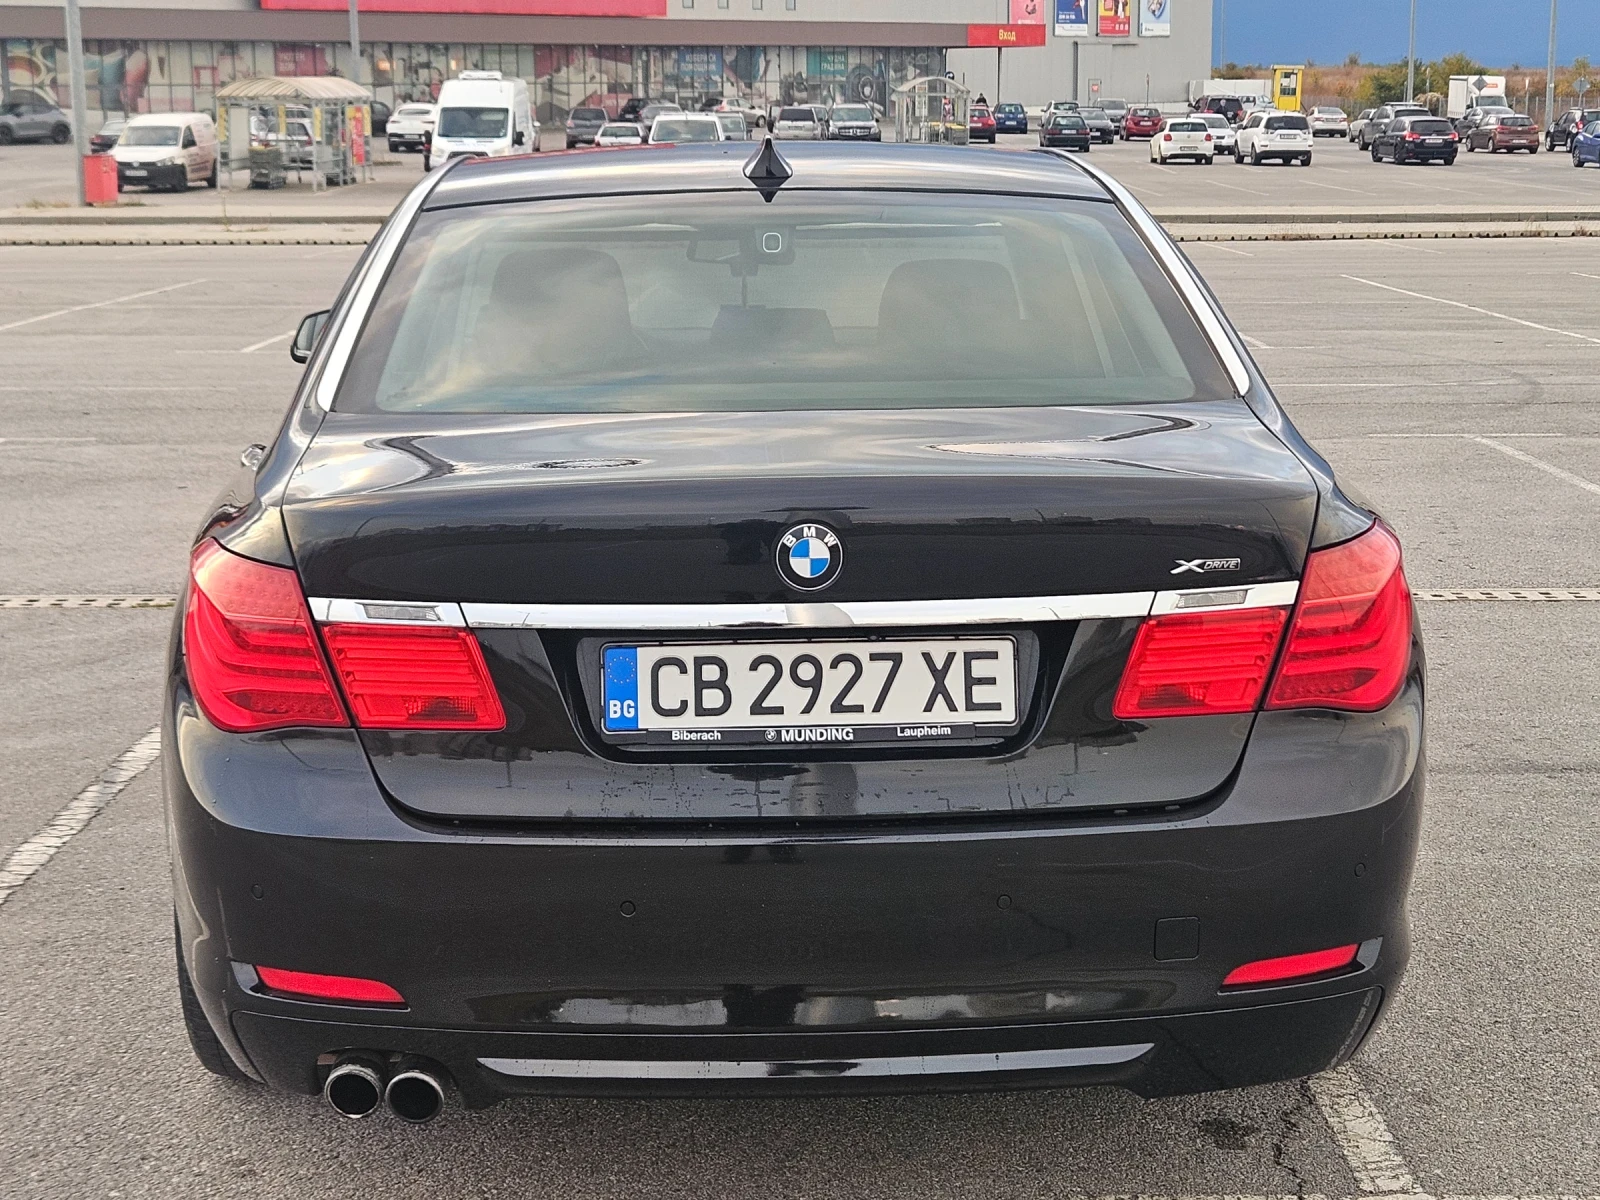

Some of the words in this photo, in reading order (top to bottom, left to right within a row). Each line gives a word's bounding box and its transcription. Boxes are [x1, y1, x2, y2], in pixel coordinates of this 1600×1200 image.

[998, 29, 1016, 42] Вход
[782, 526, 837, 548] BMW
[650, 654, 732, 717] CB
[748, 652, 904, 715] 2927
[921, 651, 1003, 713] XE
[609, 699, 635, 718] BG
[671, 730, 721, 741] Biberach
[781, 728, 854, 742] MUNDING
[897, 726, 951, 738] Laupheim
